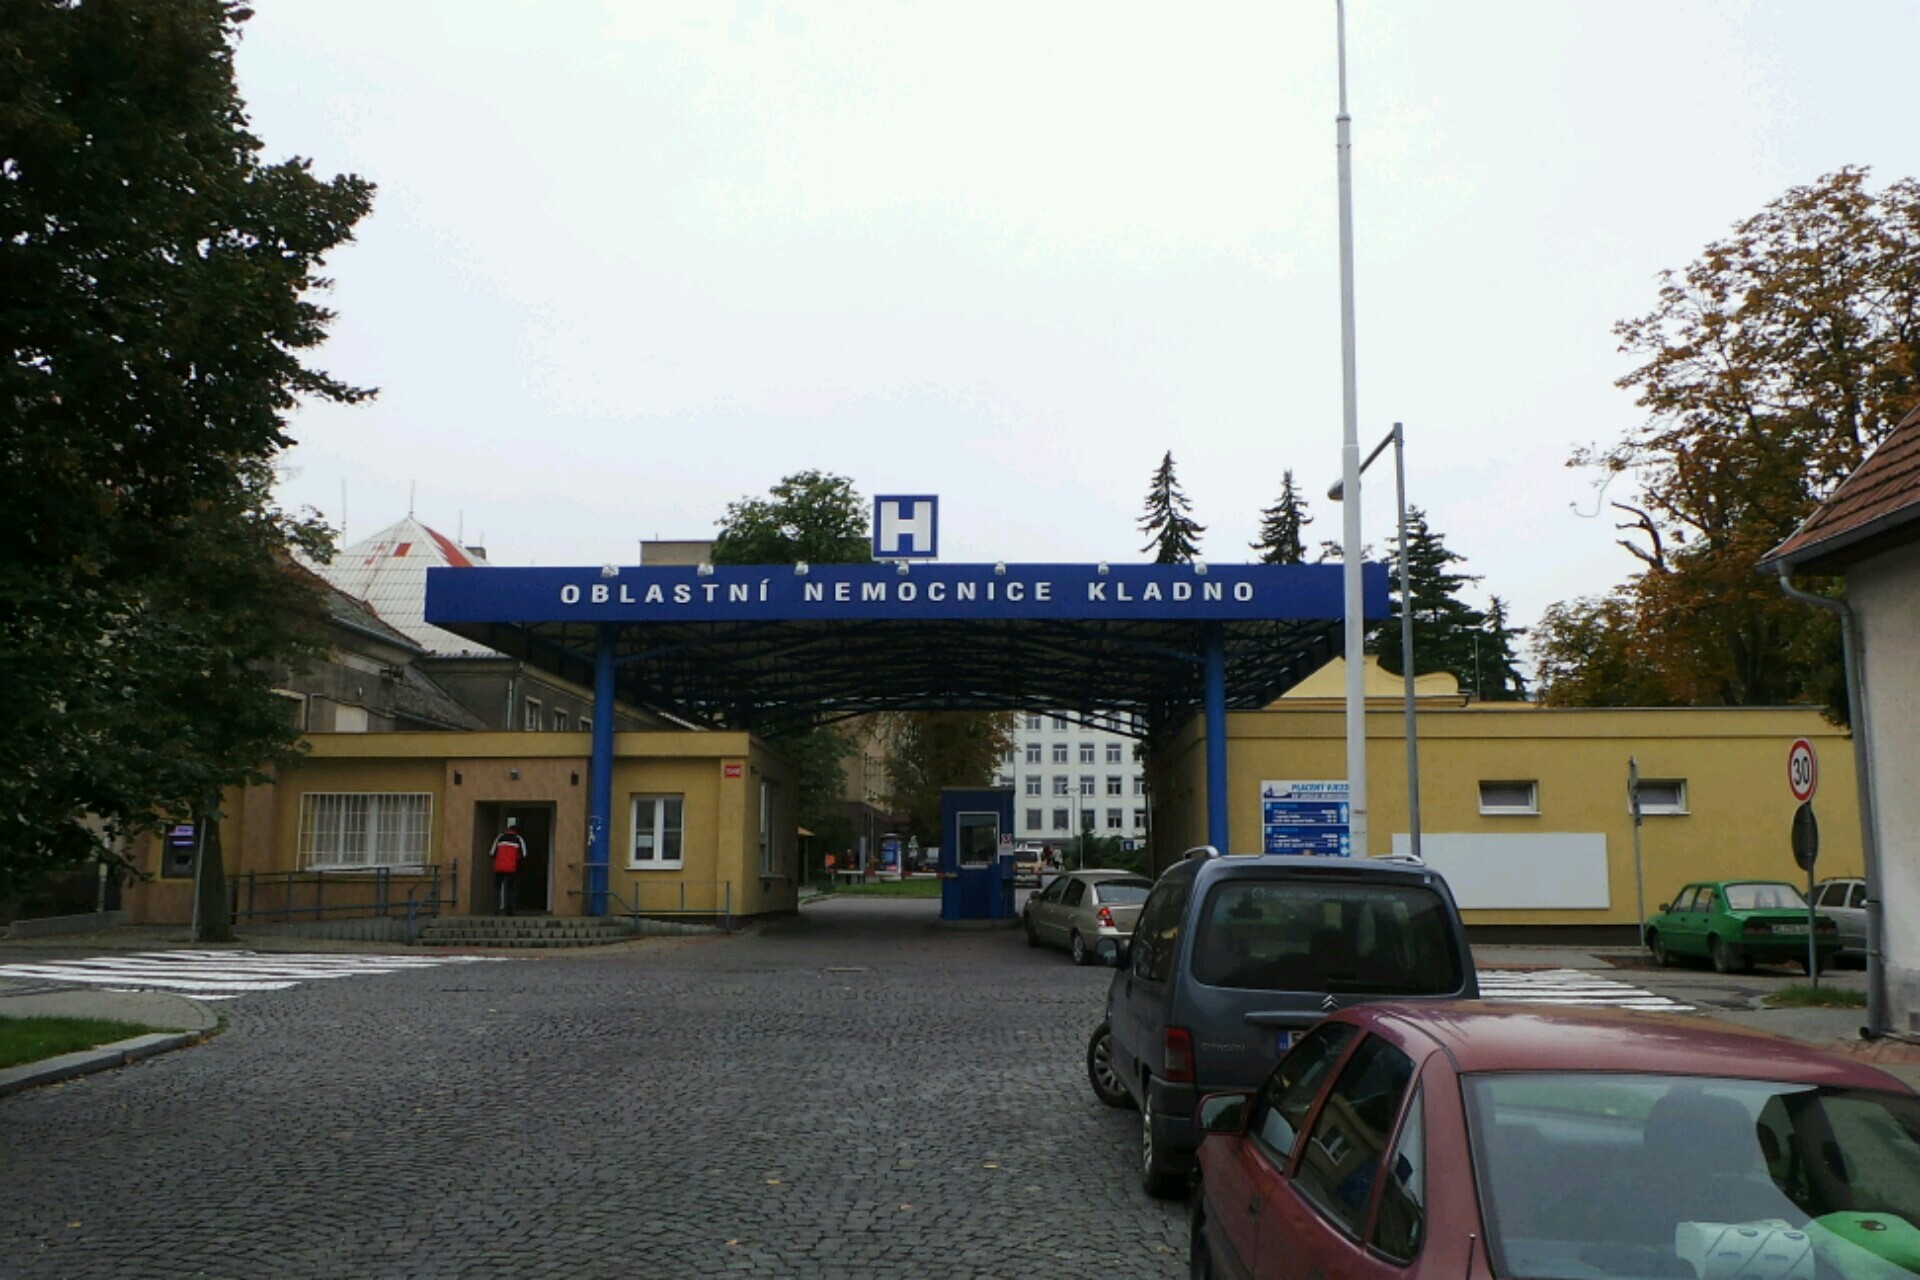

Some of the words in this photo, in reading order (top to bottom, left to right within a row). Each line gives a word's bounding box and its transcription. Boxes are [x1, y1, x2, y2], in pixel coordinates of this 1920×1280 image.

[880, 501, 932, 552] H
[560, 577, 771, 604] OBLASTNÍ
[804, 581, 1053, 603] NEMOCNICE
[1088, 581, 1255, 602] KLADNO
[1793, 756, 1811, 787] 30
